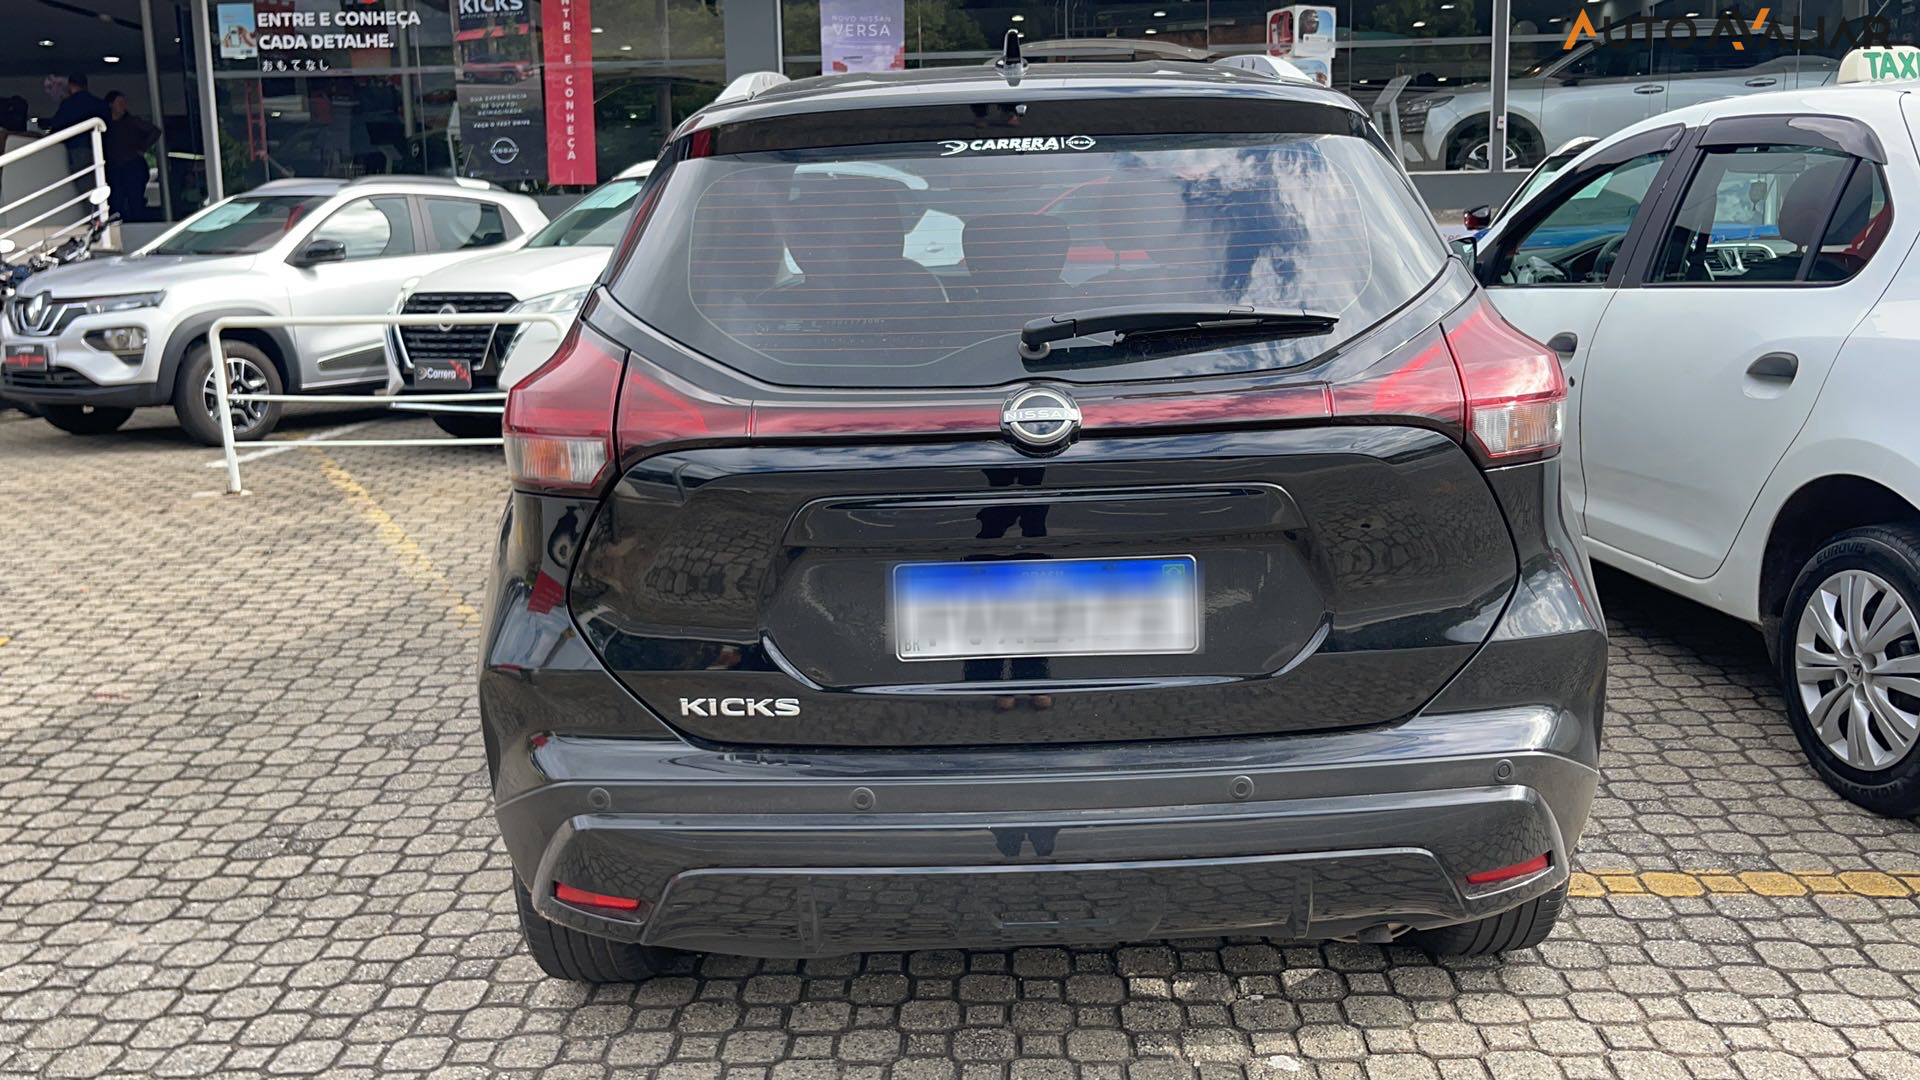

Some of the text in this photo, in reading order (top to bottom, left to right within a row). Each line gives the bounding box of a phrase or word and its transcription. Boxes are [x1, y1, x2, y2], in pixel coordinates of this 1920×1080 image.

[459, 0, 523, 14] KICKS
[257, 11, 421, 29] ENTRE E CONHEÇA
[832, 24, 890, 37] VERSA
[259, 33, 394, 50] CADA DETALHE.
[262, 58, 329, 72] おもてなし
[1862, 52, 1920, 79] TAXI
[564, 75, 576, 160] CONHEÇA
[970, 137, 1059, 151] CARRERA
[1005, 409, 1078, 422] NISSAN
[680, 698, 800, 717] KICKS
